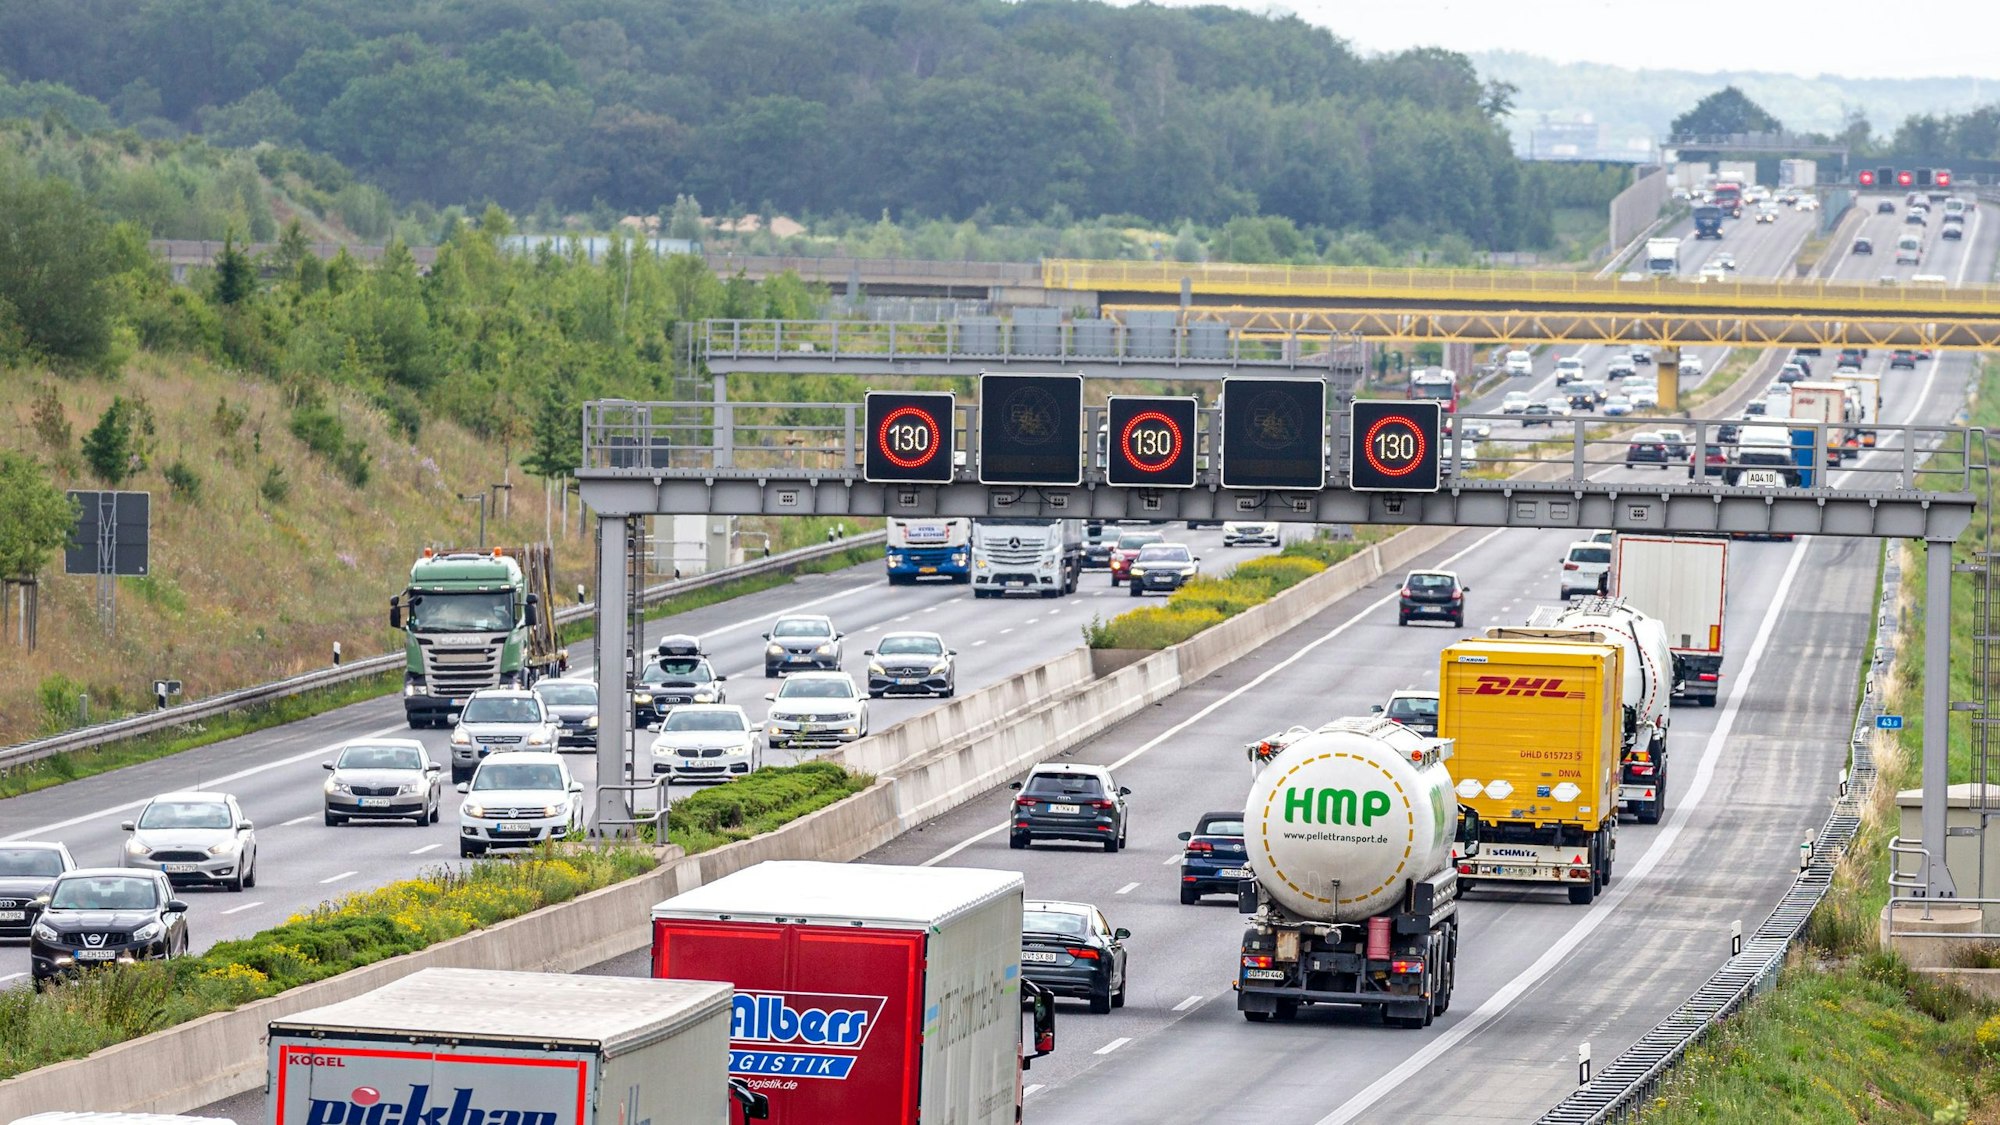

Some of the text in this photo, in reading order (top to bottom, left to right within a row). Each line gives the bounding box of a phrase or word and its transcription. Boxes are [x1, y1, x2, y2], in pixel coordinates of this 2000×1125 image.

[889, 425, 929, 451] 130
[1131, 429, 1171, 456] 130
[1375, 433, 1414, 460] 130
[1749, 474, 1774, 483] AQ4.10
[441, 635, 482, 644] SCANIA
[1474, 676, 1568, 698] DHL
[1520, 751, 1542, 759] DHLD
[1544, 751, 1573, 760] 615723
[1558, 769, 1582, 778] DNVA
[1284, 787, 1391, 828] HMP
[1284, 832, 1388, 845] www.pellettransport.de
[1492, 849, 1538, 858] SCHMITZ
[731, 993, 867, 1044] Albers
